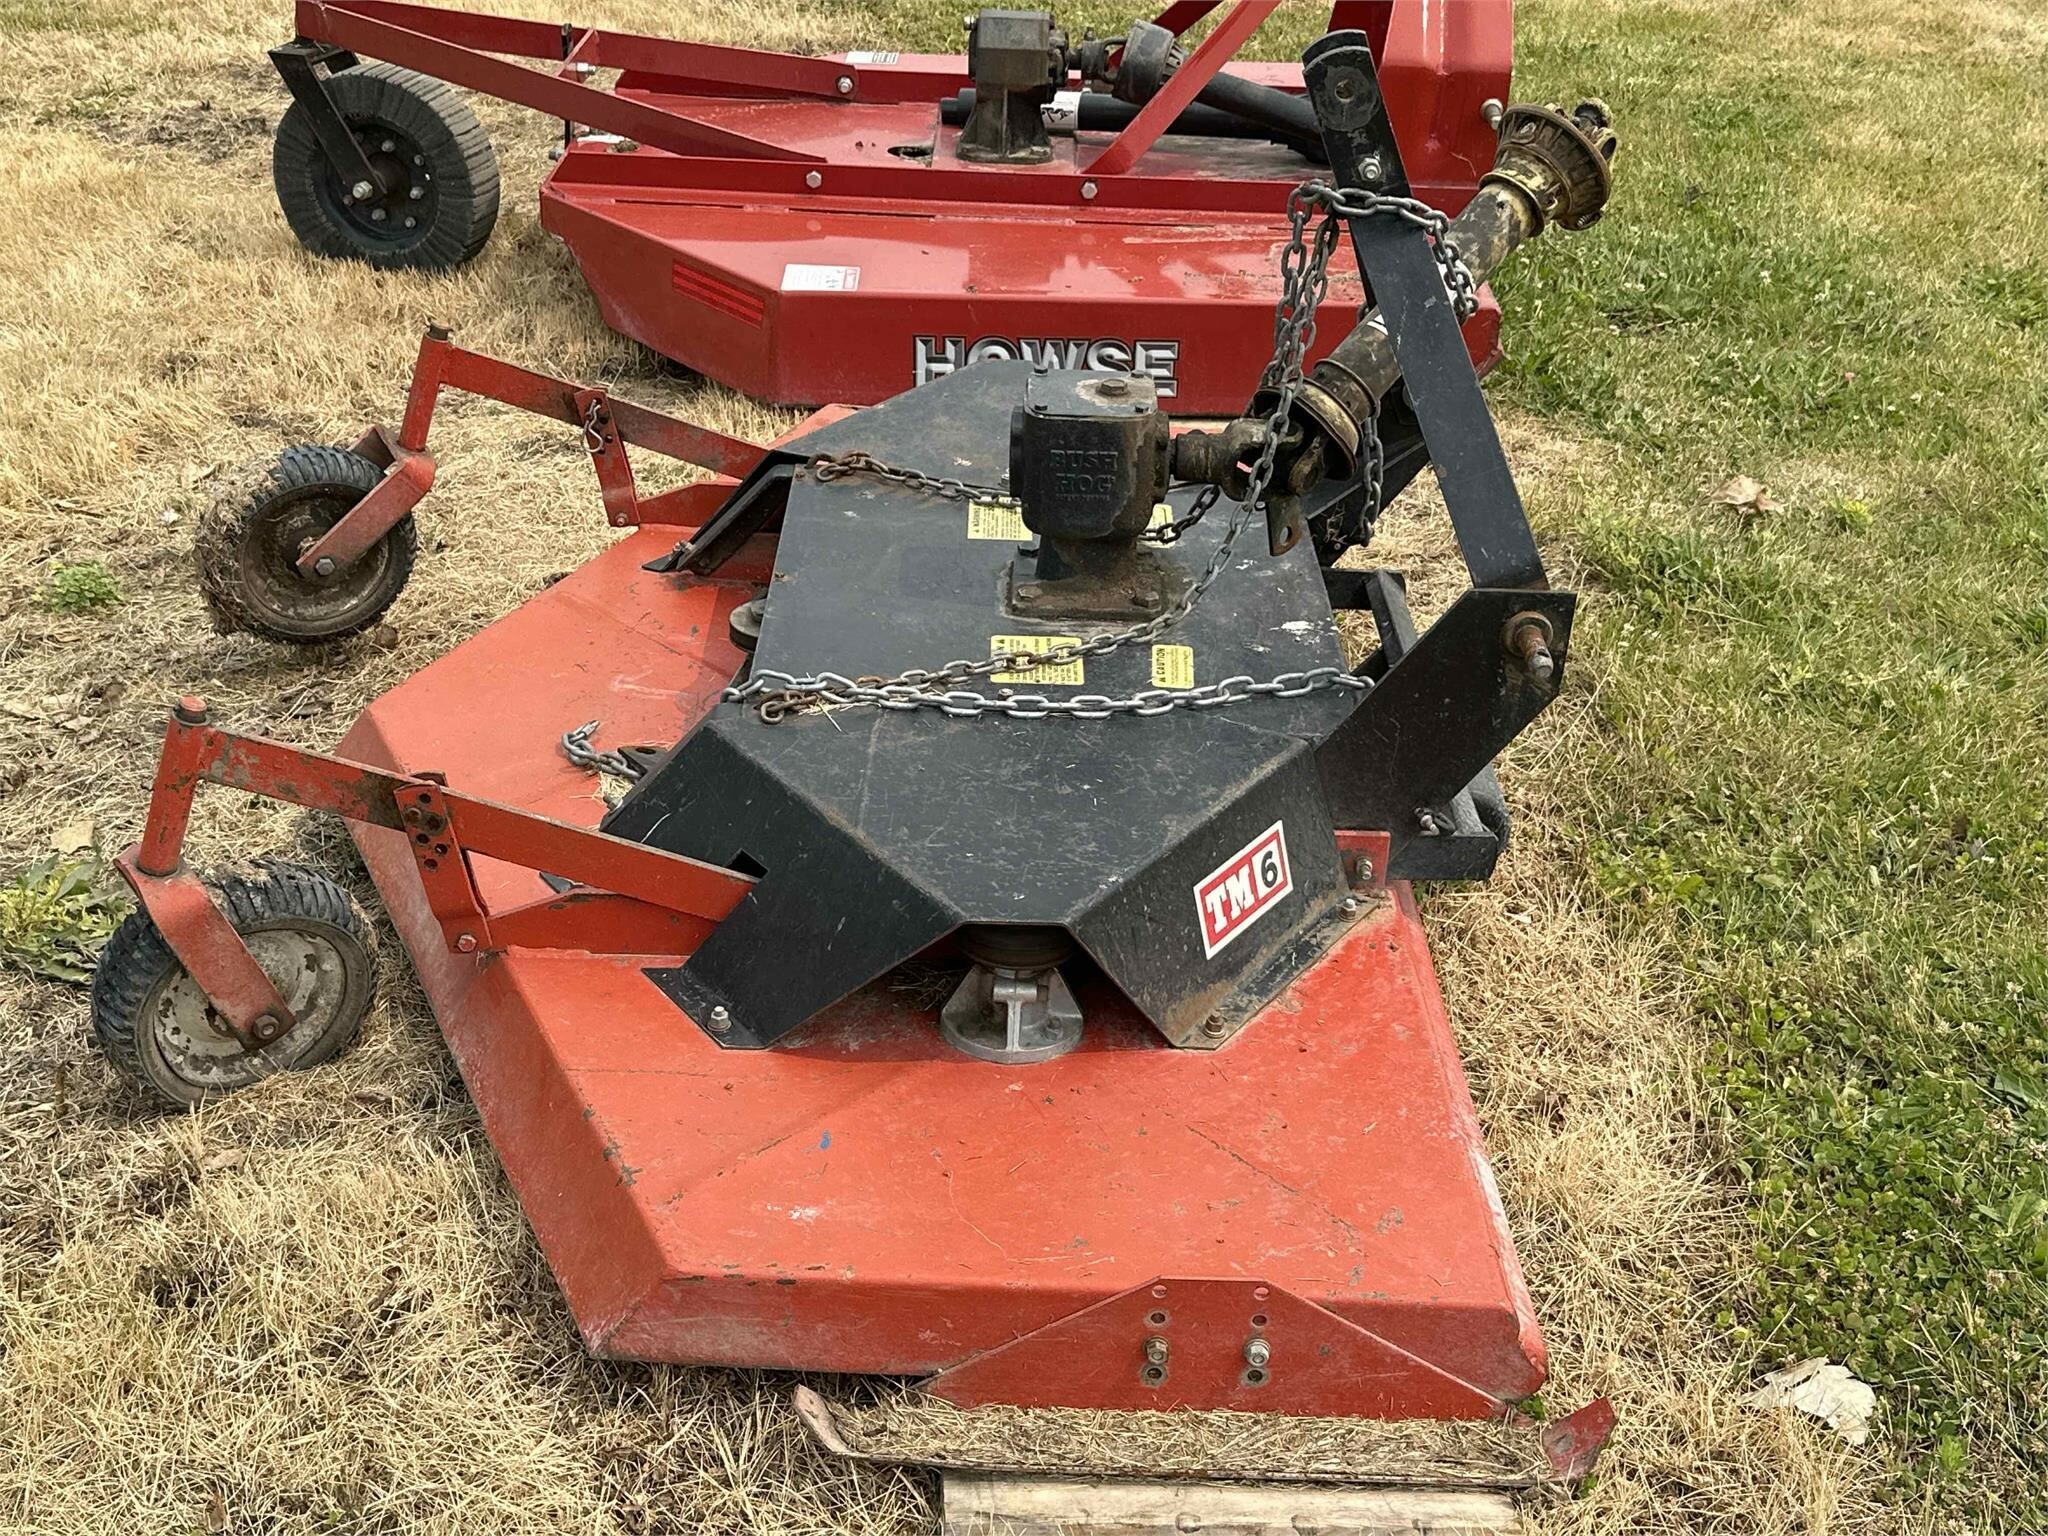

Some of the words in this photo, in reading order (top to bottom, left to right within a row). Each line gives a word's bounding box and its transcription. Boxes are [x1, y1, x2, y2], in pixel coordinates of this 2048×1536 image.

[1049, 449, 1119, 471] BUSH
[1055, 472, 1116, 493] HOG
[1156, 647, 1166, 675] CAUTION
